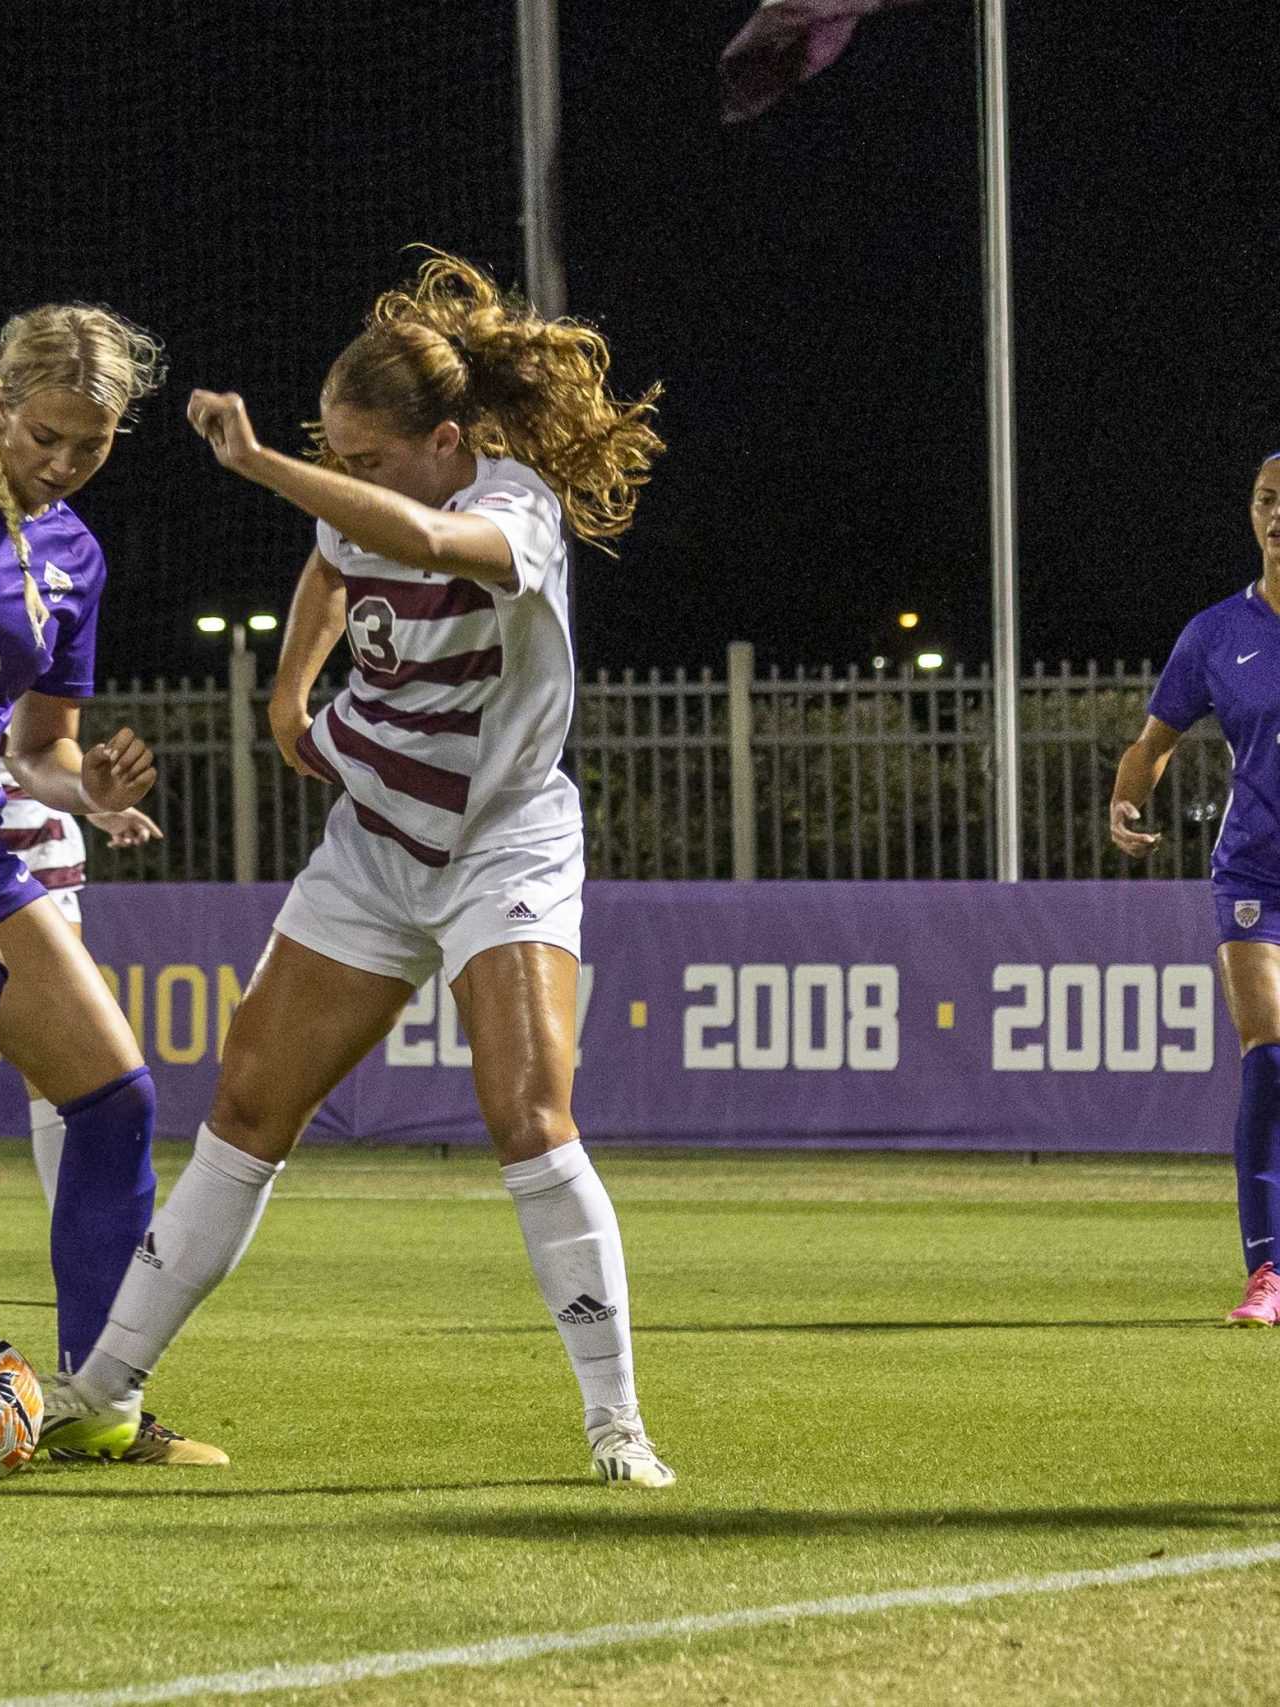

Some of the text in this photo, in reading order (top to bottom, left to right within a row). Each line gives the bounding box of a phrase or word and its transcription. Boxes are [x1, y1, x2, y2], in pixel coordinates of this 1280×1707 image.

[683, 963, 899, 1071] 2008
[992, 963, 1214, 1073] 2009
[558, 1305, 617, 1325] adidas
